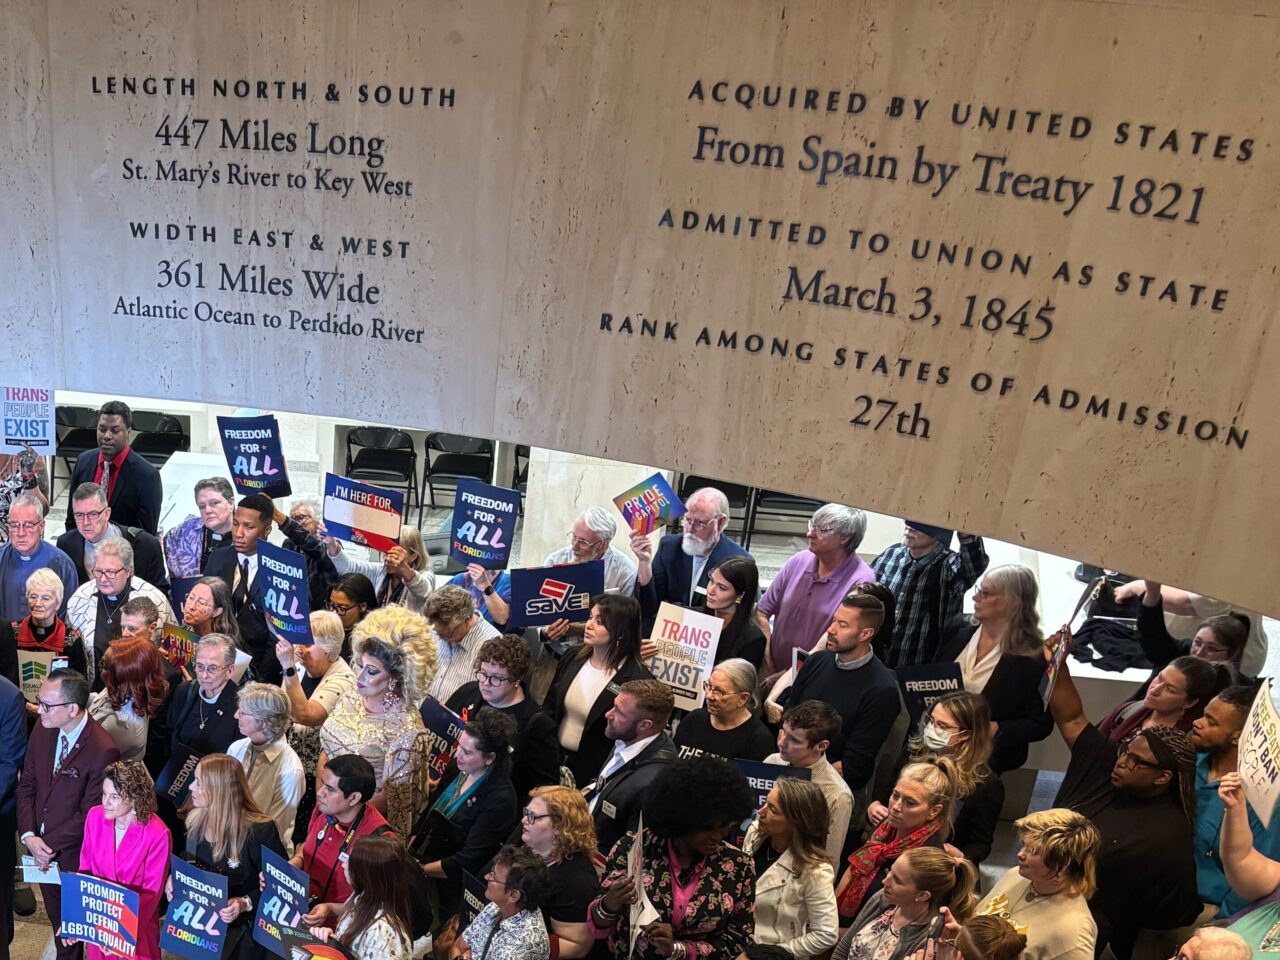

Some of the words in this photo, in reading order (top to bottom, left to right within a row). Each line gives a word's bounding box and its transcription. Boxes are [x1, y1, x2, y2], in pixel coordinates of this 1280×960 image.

[92, 76, 196, 97] LENGTH
[213, 79, 307, 101] NORTH
[324, 83, 341, 103] &
[358, 84, 455, 108] SOUTH
[688, 80, 868, 115] ACQUIRED
[889, 96, 931, 122] BY
[951, 103, 1093, 140] UNITED
[1114, 121, 1255, 163] STATES
[154, 115, 209, 149] 447
[218, 118, 297, 153] Miles
[307, 121, 385, 168] Long
[121, 159, 148, 181] St.
[227, 163, 279, 187] River
[286, 168, 307, 189] to
[313, 168, 354, 198] Key
[361, 170, 412, 197] West
[692, 126, 785, 170] From
[798, 134, 899, 187] Spain
[913, 144, 959, 196] by
[972, 152, 1093, 215] Treaty
[1107, 175, 1206, 225] 1821
[129, 222, 217, 243] WIDTH
[234, 227, 294, 249] EAST
[310, 233, 324, 252] &
[342, 236, 410, 259] WEST
[658, 207, 827, 247] ADMITTED
[850, 229, 891, 255] TO
[912, 238, 1031, 276] UNION
[1053, 261, 1094, 286] AS
[1115, 271, 1230, 313] STATE
[157, 259, 207, 289] 361
[218, 262, 293, 297] Miles
[302, 268, 380, 304] Wide
[782, 266, 897, 316] March
[908, 285, 943, 327] 3,
[959, 292, 1058, 342] 1845
[113, 296, 188, 321] Atlantic
[194, 301, 255, 327] Ocean
[262, 307, 282, 329] to
[289, 309, 364, 337] Perdido
[371, 316, 425, 344] River
[599, 312, 679, 342] RANK
[695, 327, 815, 363] AMONG
[833, 347, 951, 387] STATES
[970, 370, 1016, 398] OF
[1032, 383, 1250, 451] ADMISSION
[4, 403, 49, 418] PEOPLE
[849, 394, 933, 439] 27th
[4, 419, 49, 437] EXIST
[350, 488, 371, 506] HERE
[374, 494, 391, 510] FOR
[461, 492, 513, 513] FREEDOM
[624, 484, 663, 513] PRIDE
[636, 497, 670, 520] CAPITOL
[473, 509, 495, 524] FOR
[456, 520, 506, 549] ALL
[453, 540, 505, 561] FLORIDIANS
[661, 619, 712, 649] TRANS
[656, 639, 708, 666] PEOPLE
[649, 656, 704, 689] EXIST
[79, 880, 125, 906] PROMOTE
[175, 870, 223, 899] FREEDOM
[188, 891, 209, 906] FOR
[82, 895, 123, 919] PROTECT
[172, 900, 221, 936] ALL
[85, 911, 119, 934] DEFEND
[61, 921, 96, 940] LGBTQ
[97, 929, 136, 958] EQUALITY
[167, 924, 219, 953] FLORIDIANS
